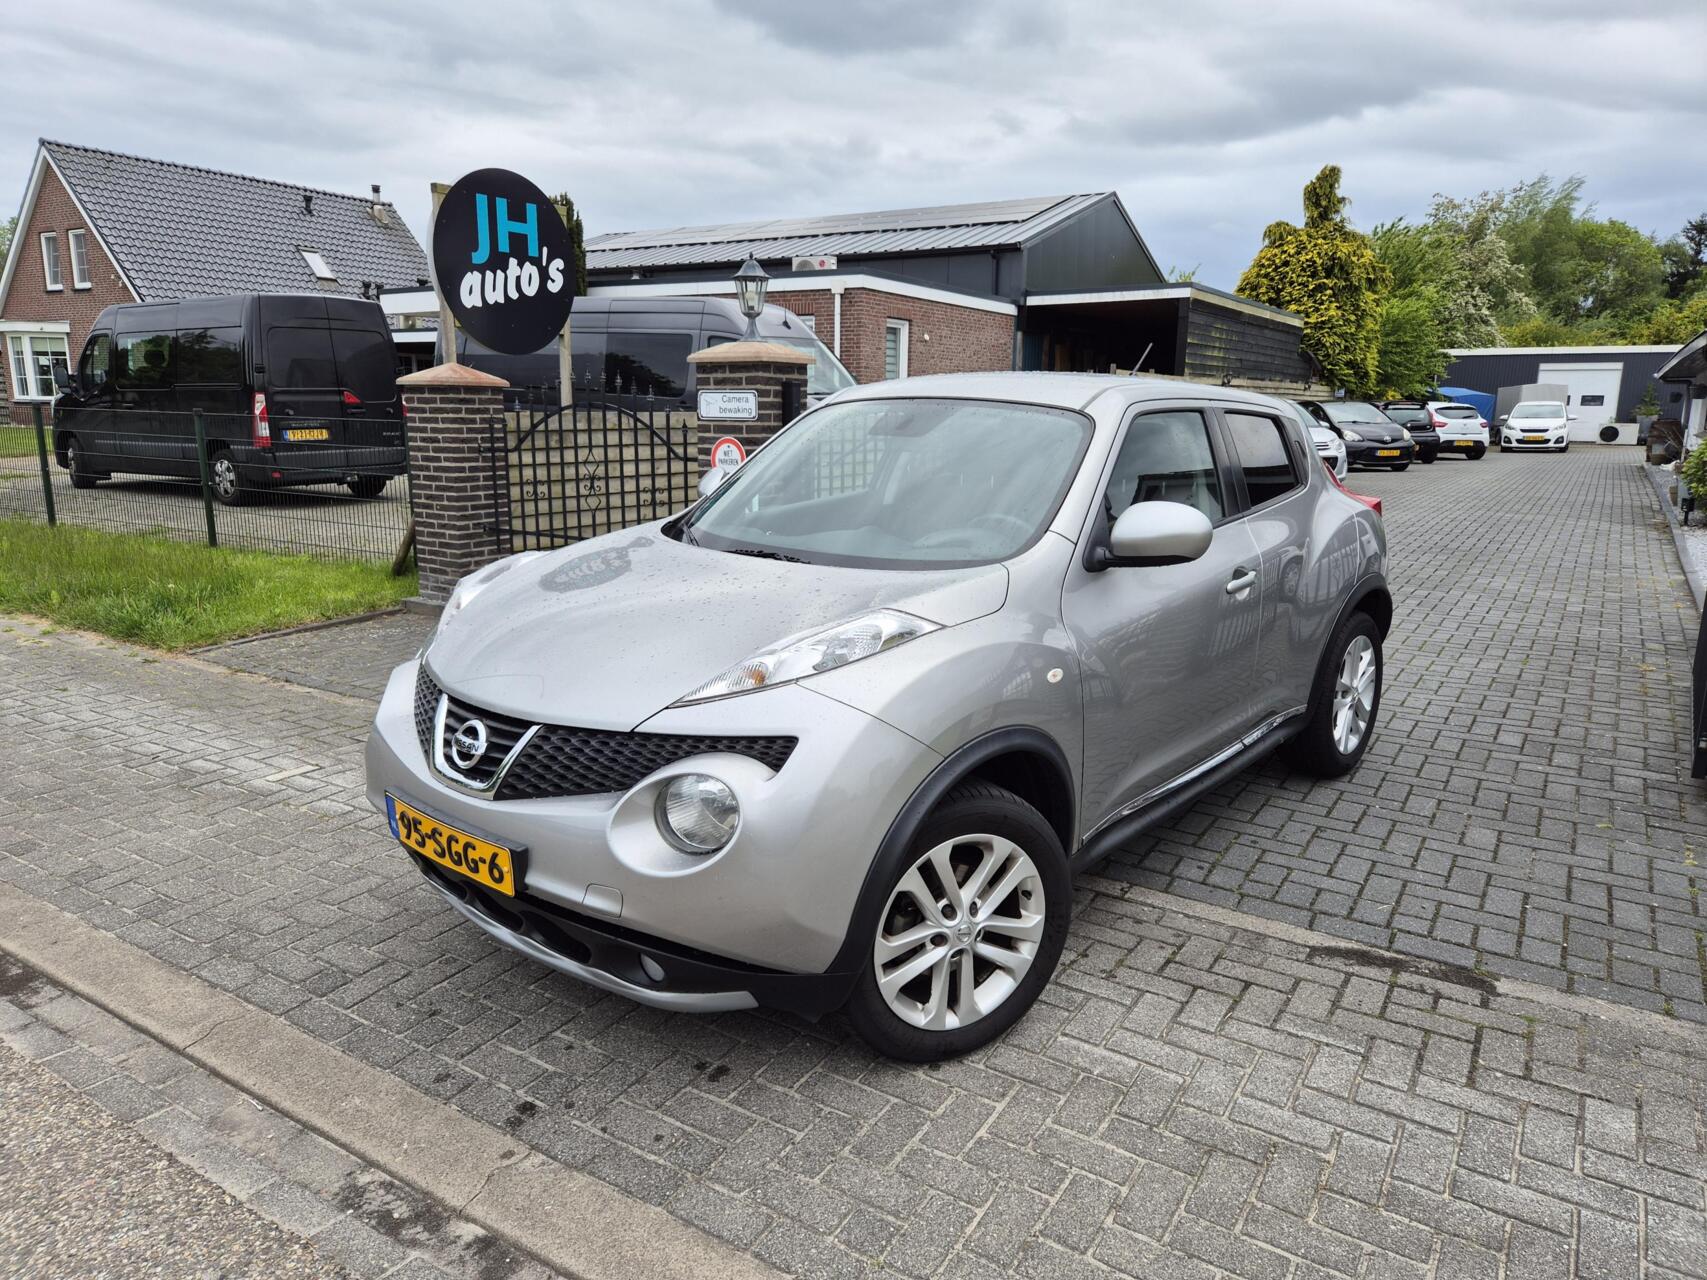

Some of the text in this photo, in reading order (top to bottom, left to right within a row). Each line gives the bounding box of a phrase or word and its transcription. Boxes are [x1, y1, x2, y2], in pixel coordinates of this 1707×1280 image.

[471, 193, 539, 264] JH
[459, 246, 565, 309] auto's
[719, 405, 752, 416] bewaking
[721, 395, 749, 403] Camera
[454, 735, 480, 752] SSAN
[399, 810, 505, 884] 95-SGG-6
